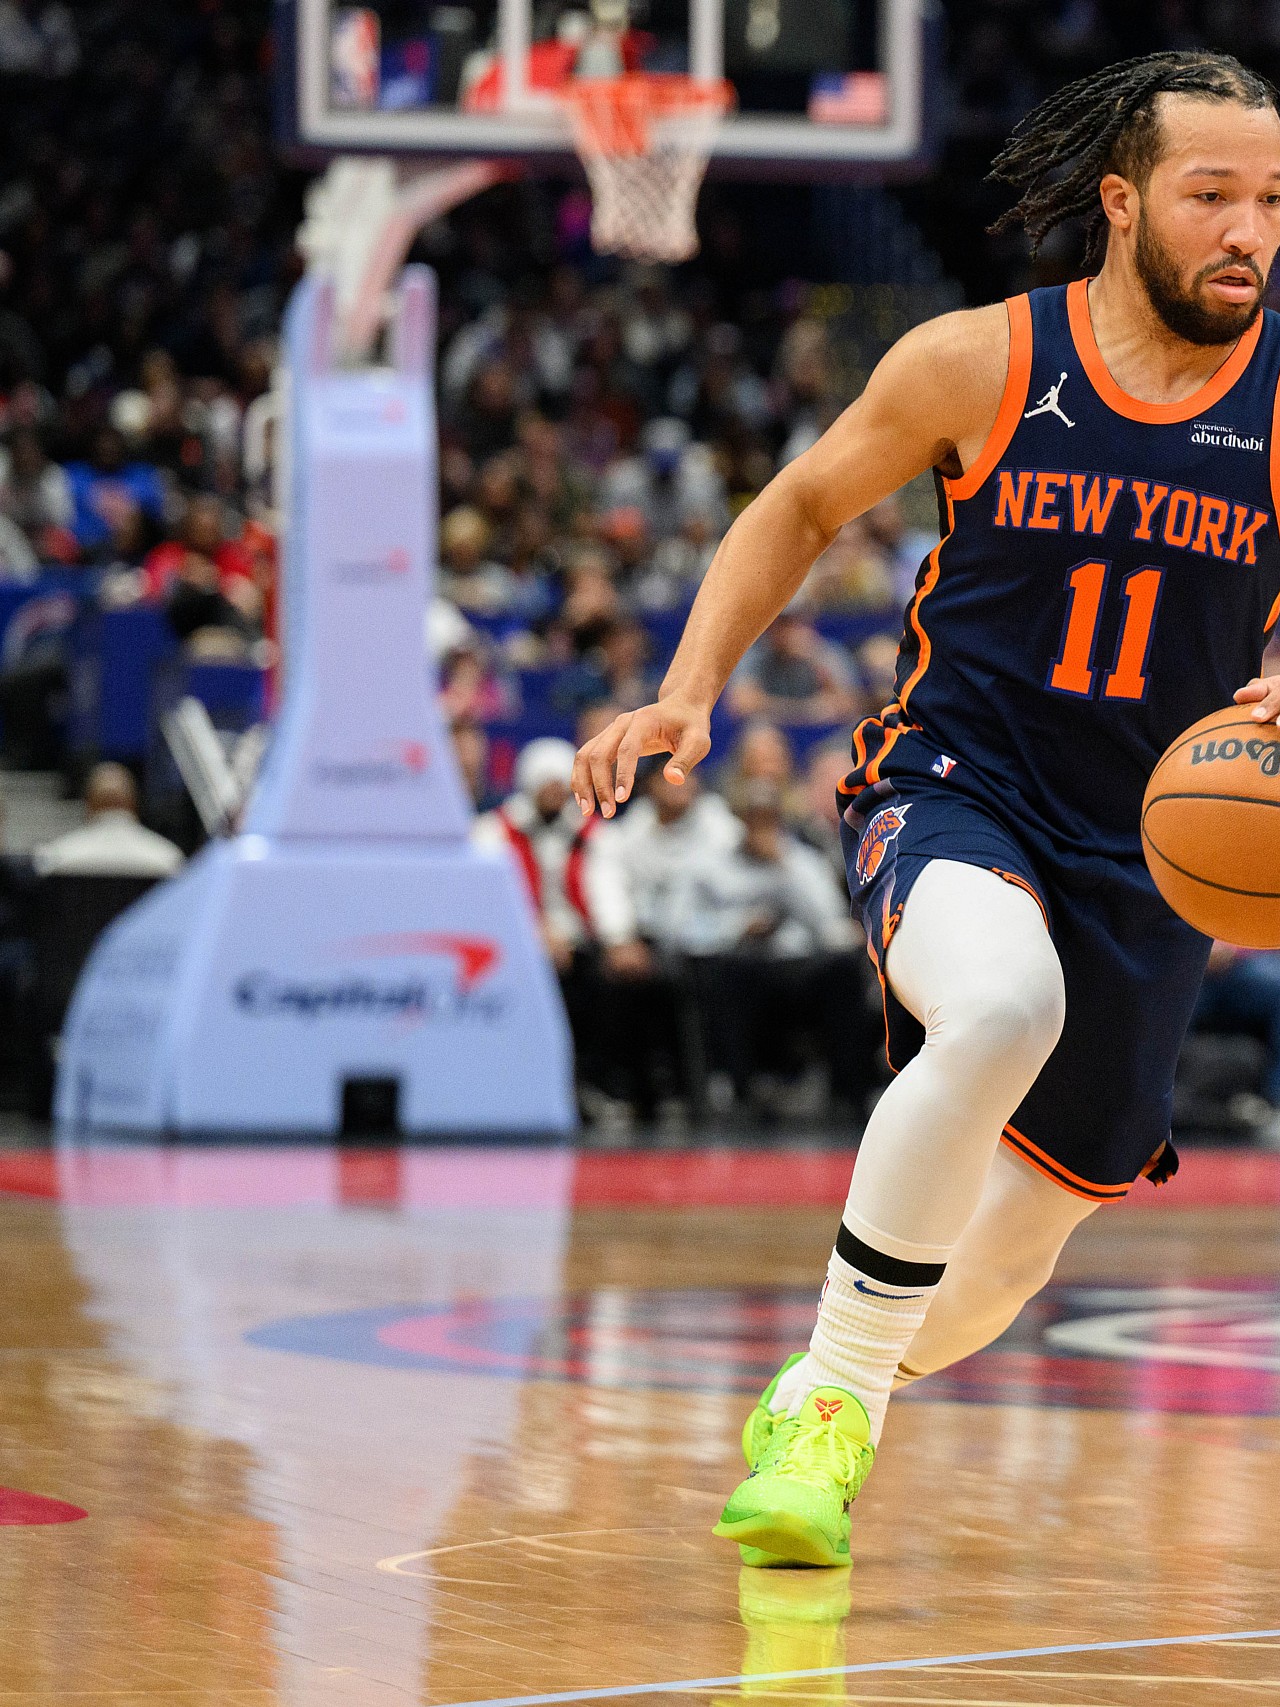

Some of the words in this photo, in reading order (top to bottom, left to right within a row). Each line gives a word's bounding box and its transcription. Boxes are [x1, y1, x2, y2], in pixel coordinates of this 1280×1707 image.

[1190, 431, 1221, 446] abu
[1193, 423, 1234, 433] experience
[993, 469, 1125, 536] NEW
[1131, 477, 1271, 566] YORK
[1046, 559, 1165, 702] 11
